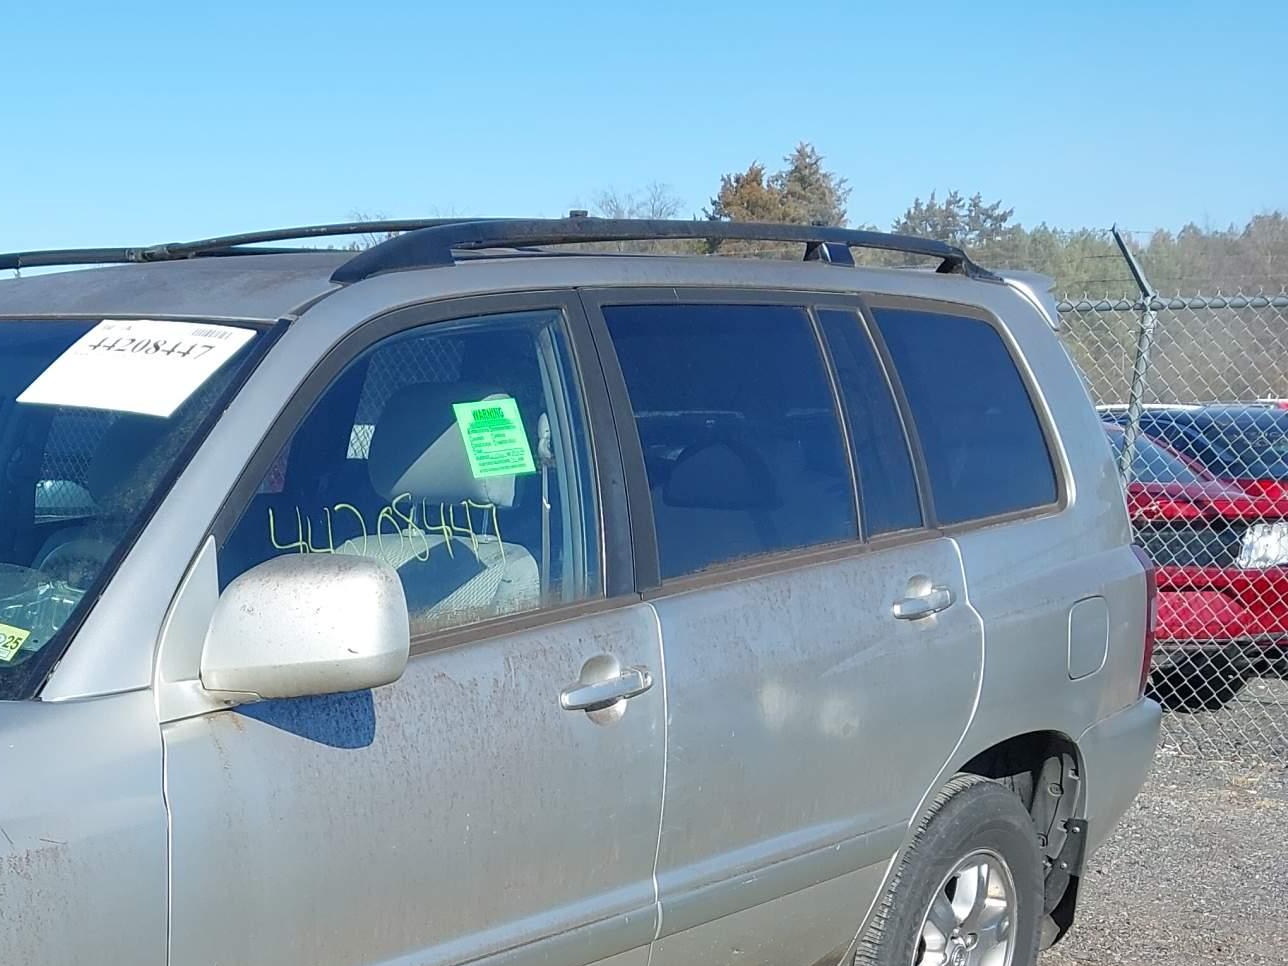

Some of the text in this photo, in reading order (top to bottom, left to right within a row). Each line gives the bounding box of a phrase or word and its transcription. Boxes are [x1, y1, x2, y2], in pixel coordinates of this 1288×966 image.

[89, 337, 215, 359] 44208447
[472, 407, 505, 421] WARNING
[268, 492, 506, 565] 44208447
[3, 635, 22, 649] 25
